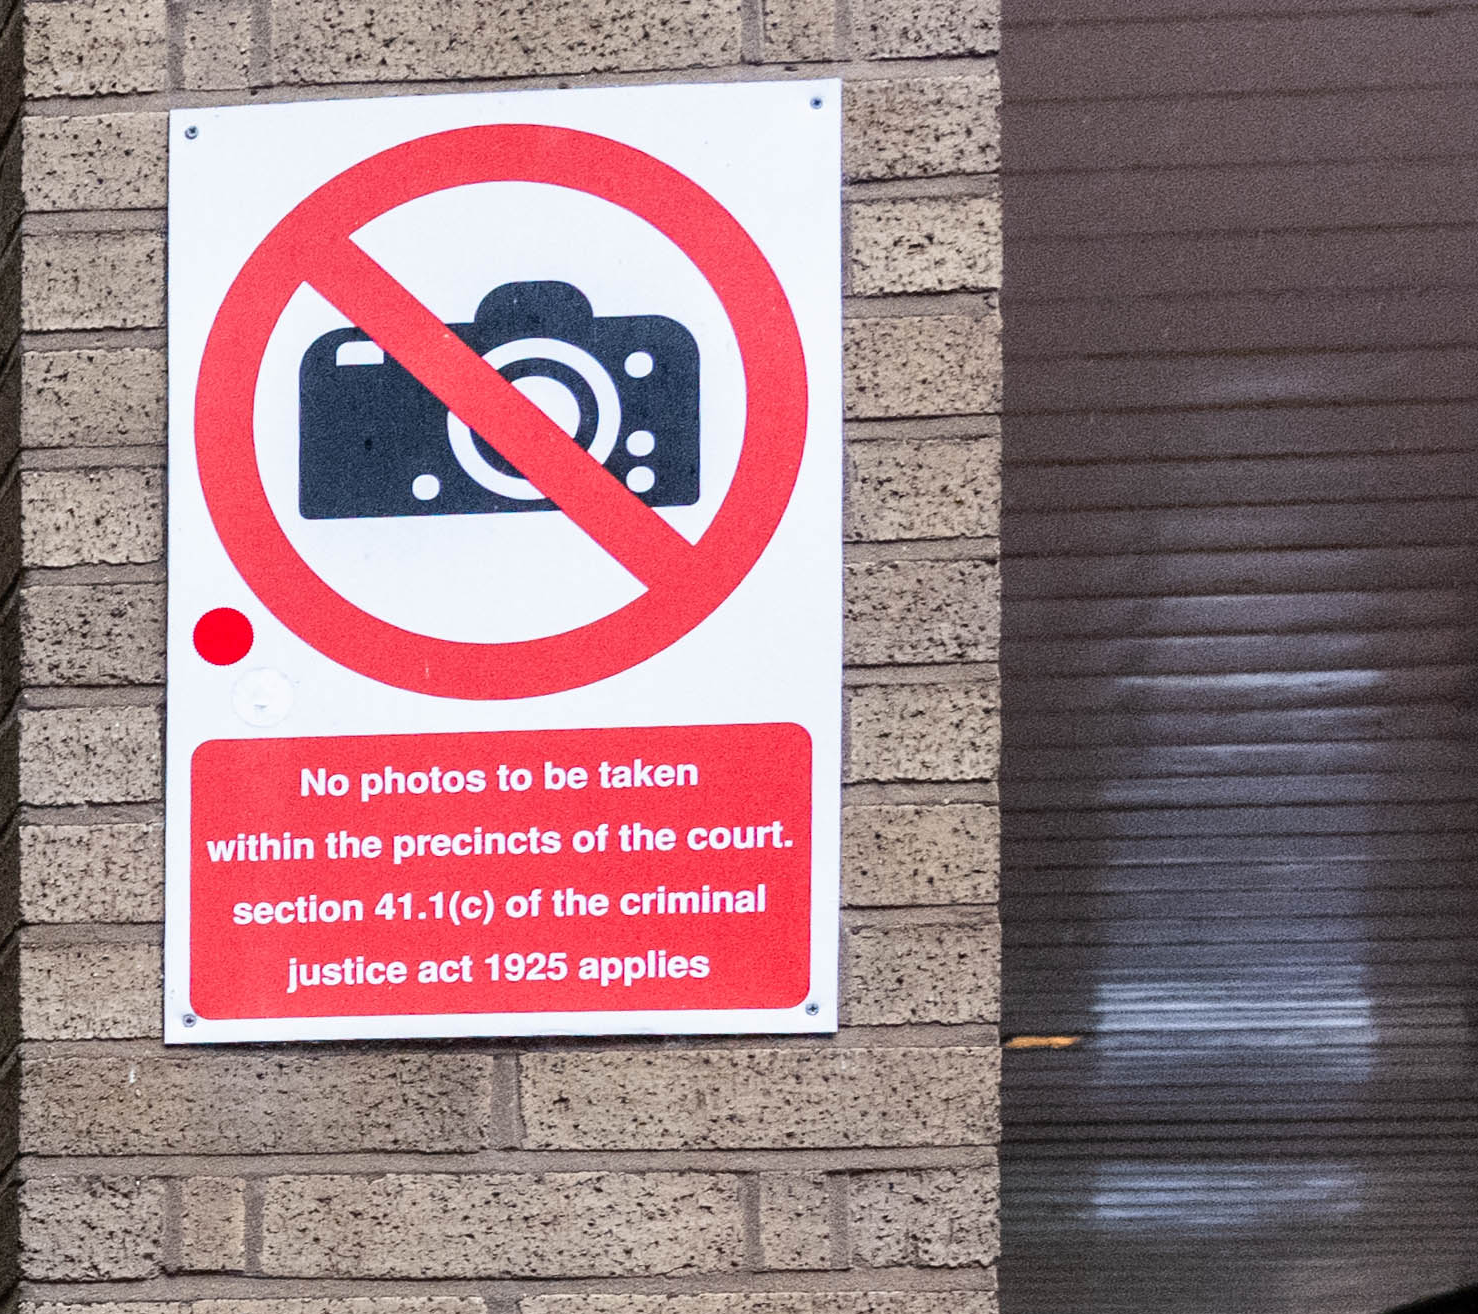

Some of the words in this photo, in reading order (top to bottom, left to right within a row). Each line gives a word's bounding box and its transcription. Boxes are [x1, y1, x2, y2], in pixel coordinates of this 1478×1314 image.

[301, 768, 350, 797] No
[361, 765, 487, 803] photos
[496, 764, 533, 792] to
[544, 761, 588, 790] be
[598, 758, 698, 789] taken
[206, 832, 315, 862] within
[325, 830, 383, 860] the
[393, 826, 562, 865] precincts
[572, 823, 609, 853] of
[618, 822, 677, 852] the
[687, 820, 793, 851] court.
[233, 894, 364, 925] section
[374, 890, 495, 926] 41.1(c)
[505, 888, 542, 918] of
[551, 887, 610, 917] the
[620, 883, 766, 916] criminal
[286, 956, 408, 994] justice
[417, 955, 473, 984] act
[484, 952, 568, 982] 1925
[578, 949, 710, 987] applies
